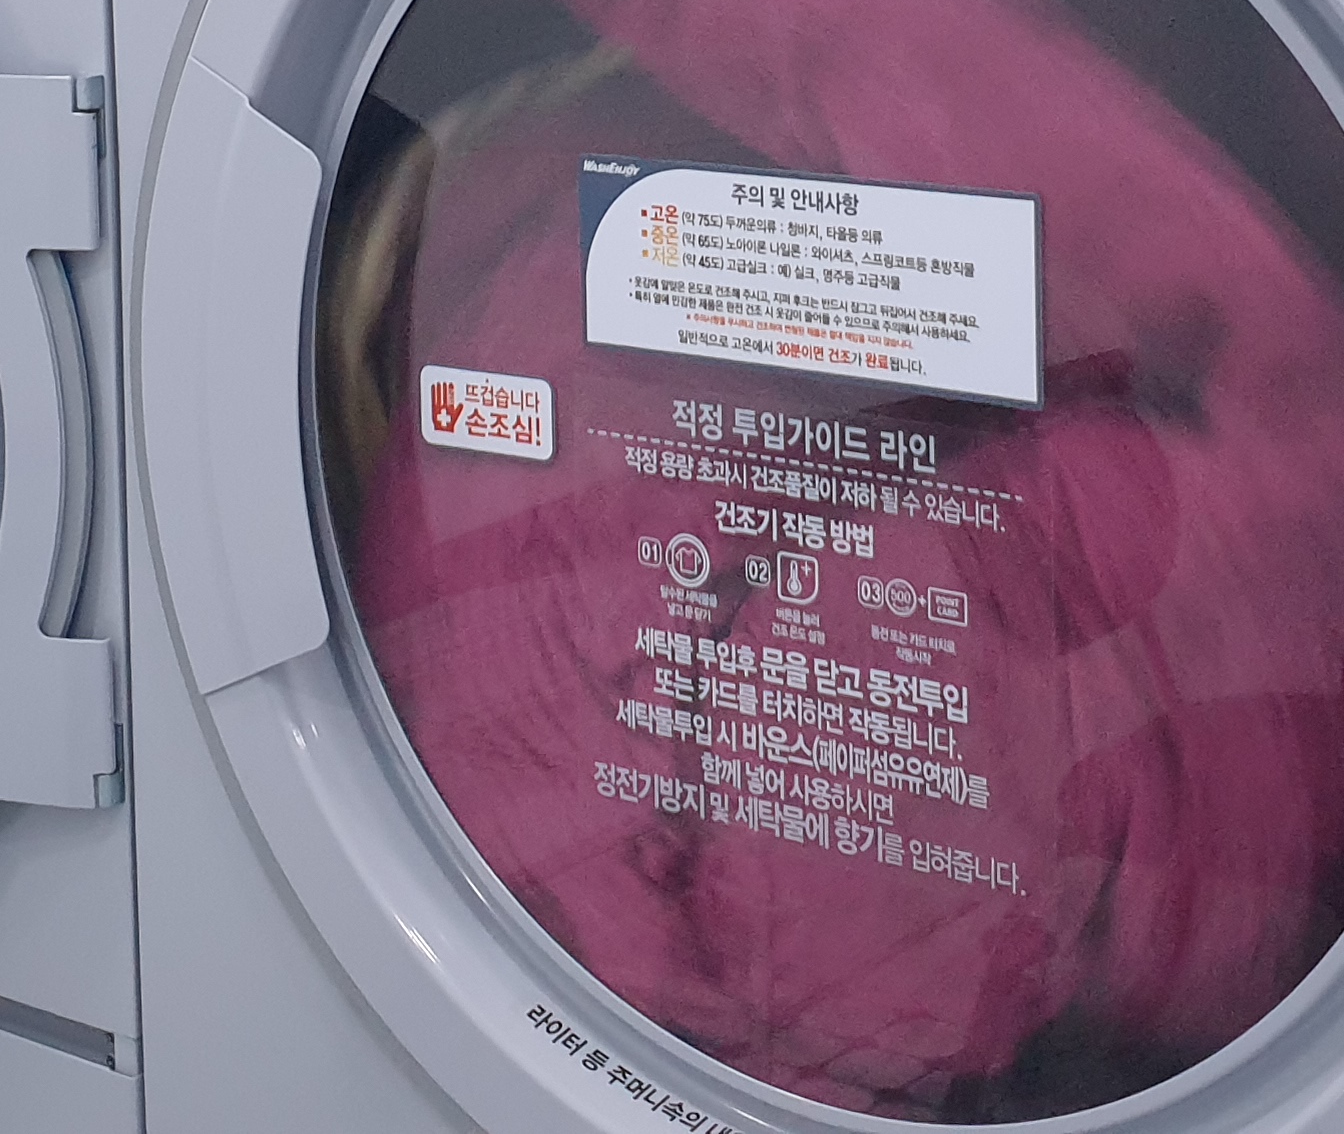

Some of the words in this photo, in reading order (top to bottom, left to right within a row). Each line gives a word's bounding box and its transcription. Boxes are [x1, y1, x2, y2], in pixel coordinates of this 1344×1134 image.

[650, 205, 679, 225] 고온
[698, 212, 724, 228] 75도)
[726, 215, 777, 235] 두꺼운의류
[861, 229, 884, 245] 의류
[731, 183, 765, 207] 주의
[769, 186, 786, 209] 및
[790, 189, 859, 216] 안내사항
[677, 329, 729, 348] 일반적으로
[731, 337, 774, 355] 고온에서
[777, 341, 825, 361] 30분이면
[828, 347, 862, 367] 건조가
[865, 352, 927, 376] 완료됩니다.
[465, 384, 540, 414] 뜨겁습니다
[465, 408, 542, 447] 손조심!
[671, 399, 723, 440] 적정
[732, 407, 870, 462] 투입가이드
[880, 429, 937, 474] 라인
[624, 446, 658, 474] 적정
[661, 450, 695, 481] 용량
[697, 457, 748, 490] 초과시
[751, 465, 838, 506] 건조품질이
[840, 479, 877, 513] 저하
[925, 492, 1007, 533] 있습니다.
[715, 500, 778, 542] 건조기
[782, 511, 827, 551] 작동
[830, 519, 875, 558] 방법
[642, 541, 659, 562] 01
[748, 560, 768, 583] 02
[861, 580, 881, 603] 03
[634, 627, 692, 666] 세탁물
[697, 638, 757, 678] 투입후
[760, 647, 809, 690] 문을
[813, 656, 864, 699] 닫고
[866, 669, 969, 724] 동전투입
[653, 667, 695, 702] 또는
[698, 677, 758, 716] 카드를
[762, 689, 844, 736] 터치하면
[848, 707, 963, 761] 작동됩니다.
[616, 698, 713, 746] 세탁물투입
[717, 719, 738, 753] 시
[741, 721, 991, 809] 바운스(페이퍼섬유유연제)를
[701, 752, 742, 786] 함께
[745, 762, 785, 798] 넣어
[788, 773, 894, 827] 사용하시면
[594, 761, 706, 821] 정전기방지
[709, 793, 731, 825] 및
[734, 795, 830, 851] 세탁물에
[834, 817, 906, 867] 향기를
[909, 838, 1027, 897] 입혀줍니다.
[526, 1004, 588, 1056] 라이터
[582, 1049, 610, 1072] 등
[606, 1064, 710, 1133] 주머니속의
